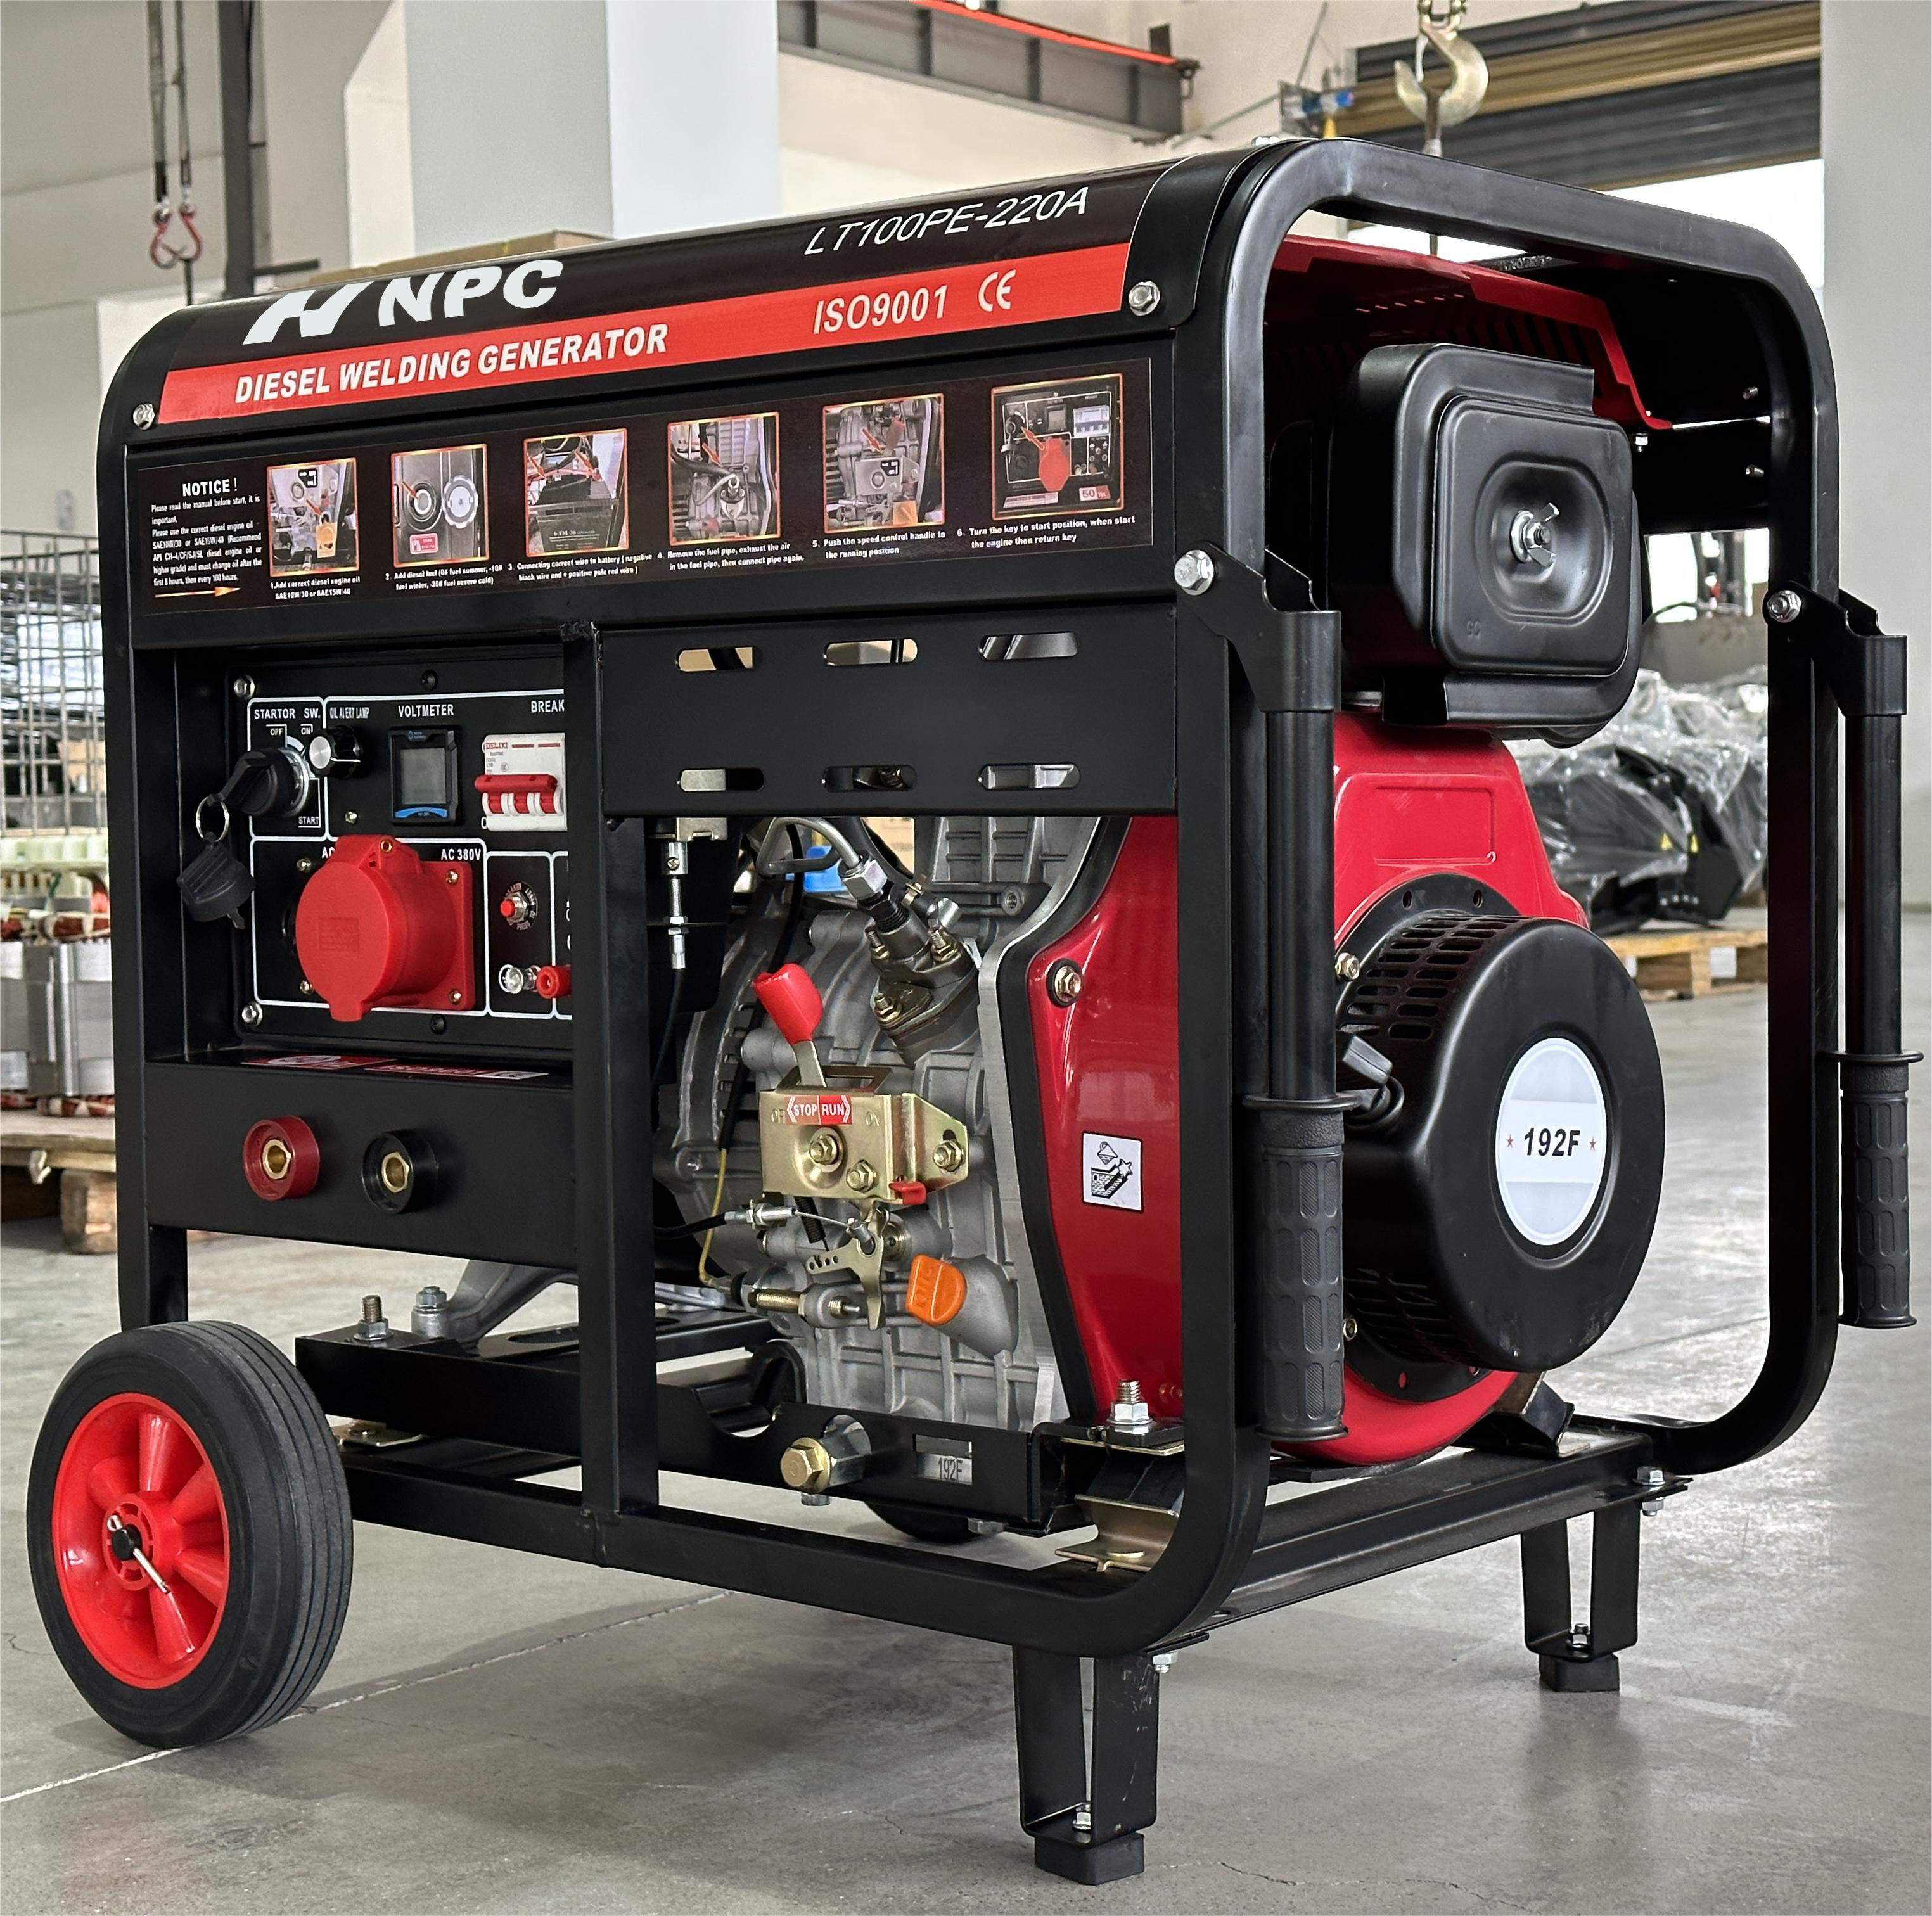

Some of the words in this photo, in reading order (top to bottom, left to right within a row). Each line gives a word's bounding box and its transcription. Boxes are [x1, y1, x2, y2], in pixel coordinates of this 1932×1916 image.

[804, 186, 1089, 255] LT100PE-220A
[379, 259, 563, 327] NPC
[813, 285, 947, 335] ISO9001
[978, 269, 1016, 312] CE
[235, 366, 331, 404] DIESEL
[340, 352, 470, 391] WELDING
[478, 323, 669, 375] GENERATOR
[182, 479, 230, 497] NOTICE
[169, 502, 181, 511] read
[193, 499, 212, 508] manual
[214, 497, 231, 506] before
[249, 495, 253, 503] it
[210, 523, 225, 532] diesel
[227, 523, 244, 532] engine
[969, 528, 987, 536] Turn
[990, 527, 1002, 535] the
[1004, 526, 1018, 535] key
[1032, 522, 1051, 530] start
[1052, 520, 1087, 530] position,
[1115, 516, 1136, 525] start
[824, 539, 841, 547] Push
[857, 535, 880, 546] speed
[881, 533, 908, 542] control
[987, 539, 1013, 547] engine
[1035, 535, 1059, 544] return
[1062, 534, 1077, 542] key
[207, 549, 221, 558] diesel
[225, 548, 242, 557] engine
[739, 545, 766, 553] exhaust
[768, 543, 779, 551] the
[840, 549, 867, 558] running
[869, 547, 899, 556] position
[153, 566, 169, 575] higher
[212, 561, 231, 570] change
[240, 559, 252, 567] after
[253, 558, 262, 566] the
[517, 561, 550, 570] Connecting
[738, 558, 765, 566] connect
[767, 556, 781, 565] pipe
[568, 570, 592, 578] positive
[254, 708, 295, 718] STARTOR
[304, 708, 321, 718] SW.
[356, 707, 369, 718] LAMP
[399, 704, 454, 717] VOLTMETER
[441, 849, 454, 860] AC
[457, 849, 481, 860] 380V
[793, 1104, 817, 1116] STOP
[822, 1104, 844, 1115] RUN
[1523, 1128, 1580, 1156] 192F
[938, 1457, 963, 1481] 192F
